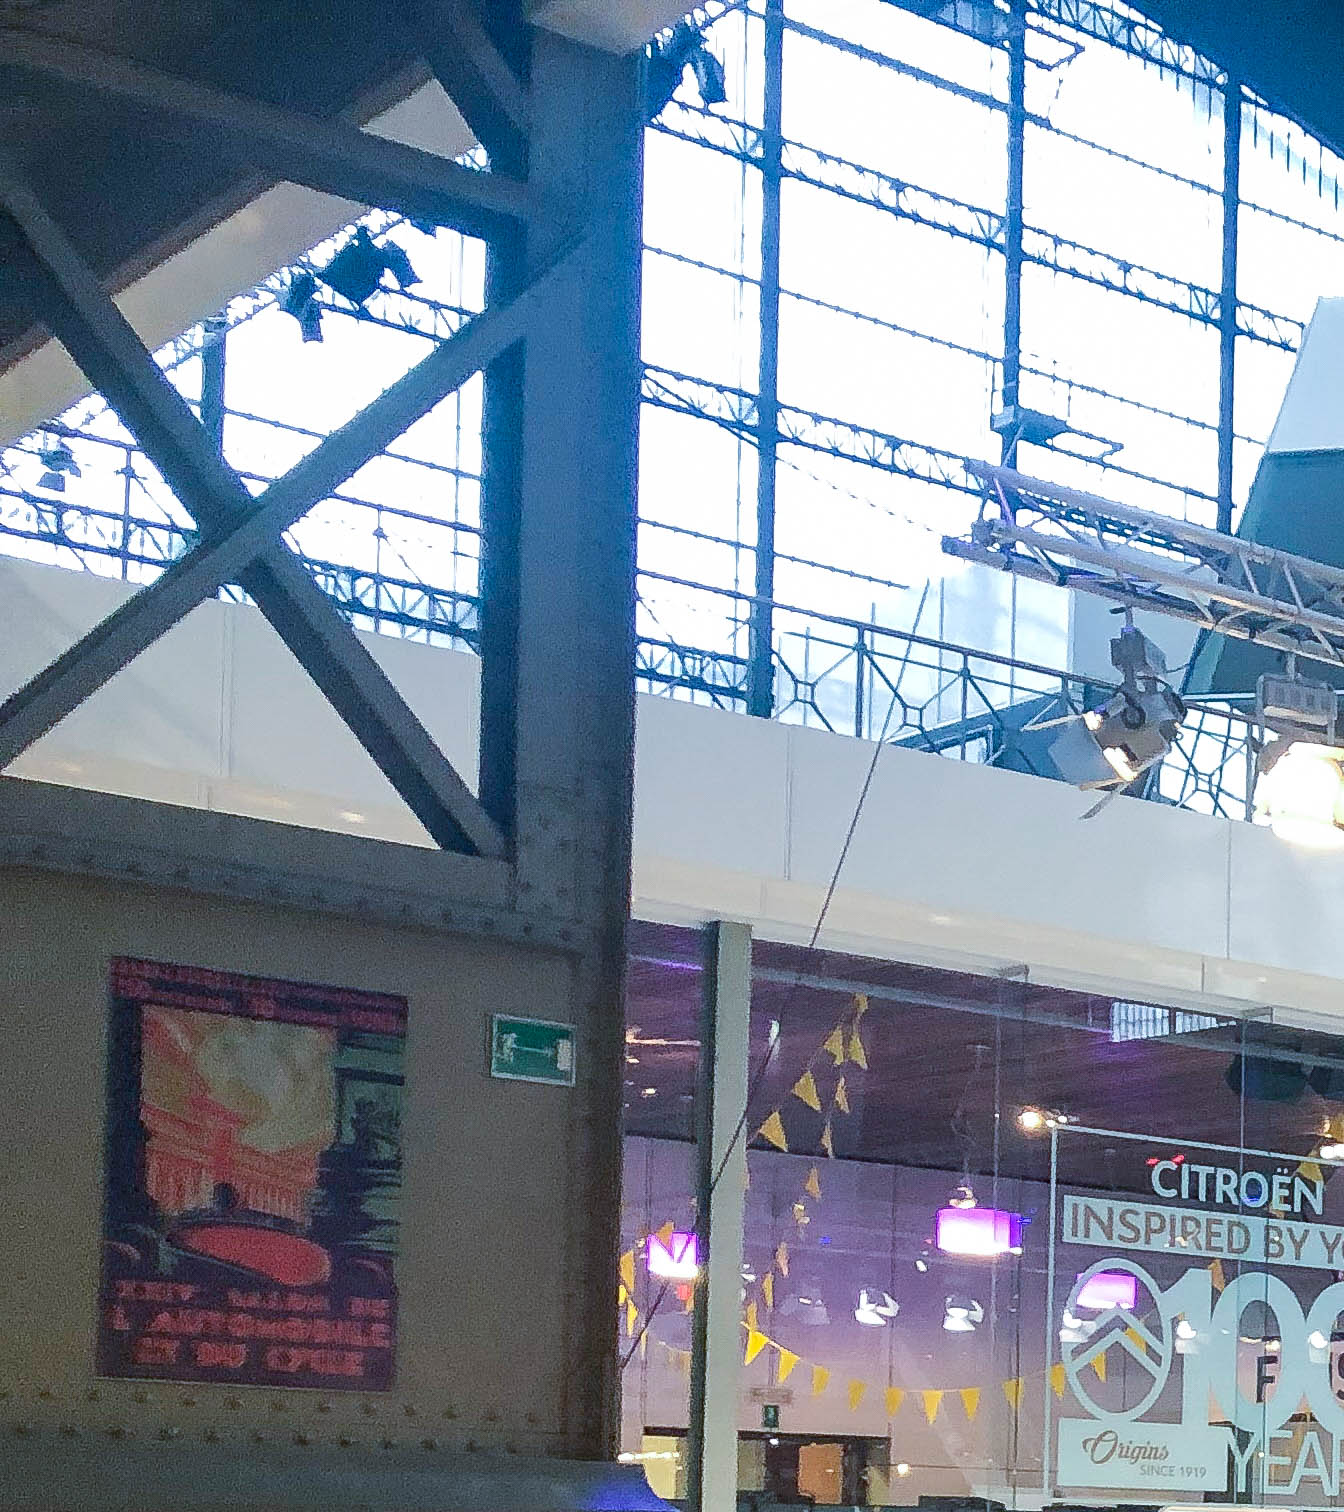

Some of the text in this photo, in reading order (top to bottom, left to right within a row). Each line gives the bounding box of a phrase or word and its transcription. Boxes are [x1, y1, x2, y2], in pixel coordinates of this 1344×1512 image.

[1151, 1160, 1325, 1215] CITROËN
[1070, 1202, 1252, 1256] INSPIRED
[1263, 1225, 1309, 1261] BY
[1082, 1430, 1169, 1464] Origins
[1139, 1464, 1207, 1478] SINCE 1919
